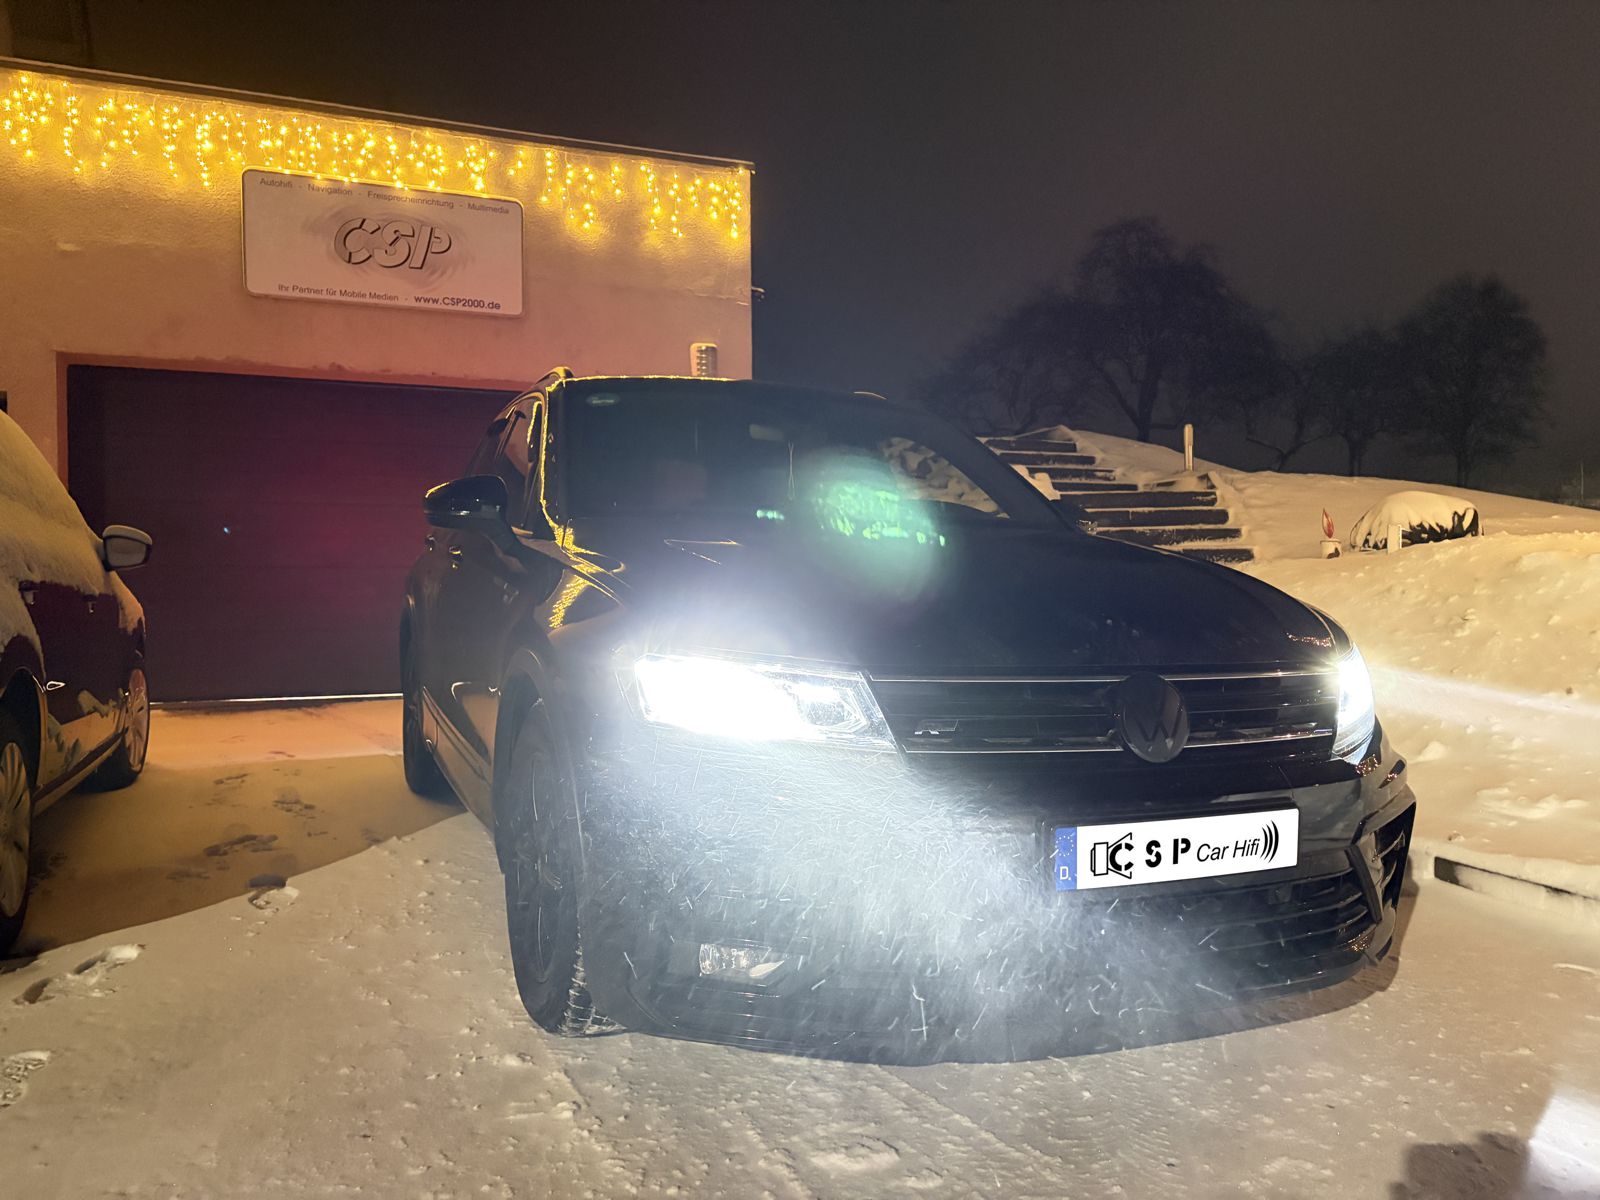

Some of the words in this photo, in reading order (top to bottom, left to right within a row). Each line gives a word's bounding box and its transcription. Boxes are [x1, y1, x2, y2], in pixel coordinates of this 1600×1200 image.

[260, 178, 293, 188] Autohifi
[308, 184, 353, 195] Navigation
[367, 191, 454, 209] Freisprecheinrichtung
[468, 203, 510, 214] Multimedia
[333, 217, 452, 270] CSP
[278, 284, 289, 292] Ihr
[292, 285, 324, 295] Partner
[326, 288, 337, 296] für
[339, 289, 367, 298] Mobile
[369, 292, 399, 301] Medien
[414, 295, 501, 310] www.CSP2000.de
[1196, 843, 1229, 862] Car
[1232, 838, 1260, 859] Hifi
